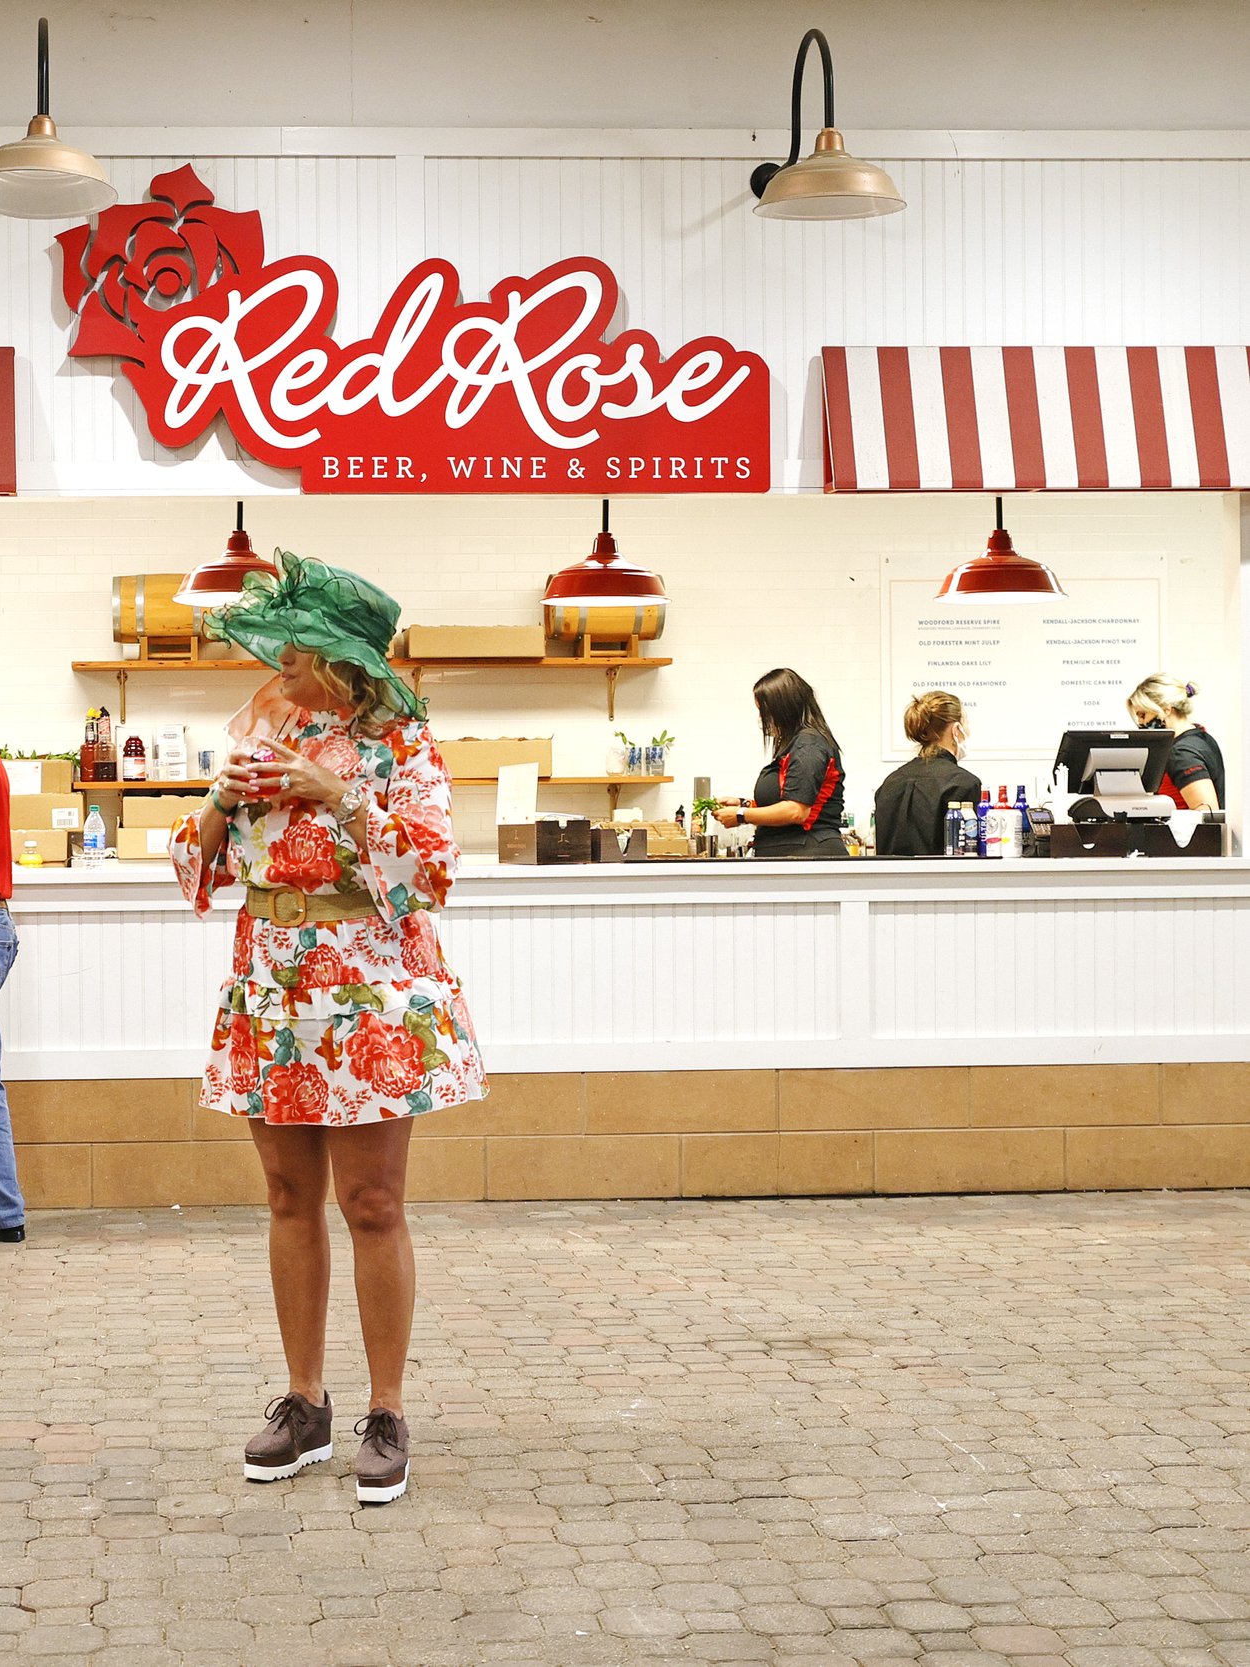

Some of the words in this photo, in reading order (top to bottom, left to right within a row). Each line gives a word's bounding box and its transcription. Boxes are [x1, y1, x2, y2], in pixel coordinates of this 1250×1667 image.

[161, 269, 452, 449] Red
[441, 269, 751, 450] Rose
[322, 456, 428, 483] BEER,
[448, 456, 548, 479] WINE
[567, 457, 586, 479] &
[606, 456, 751, 479] SPIRITS
